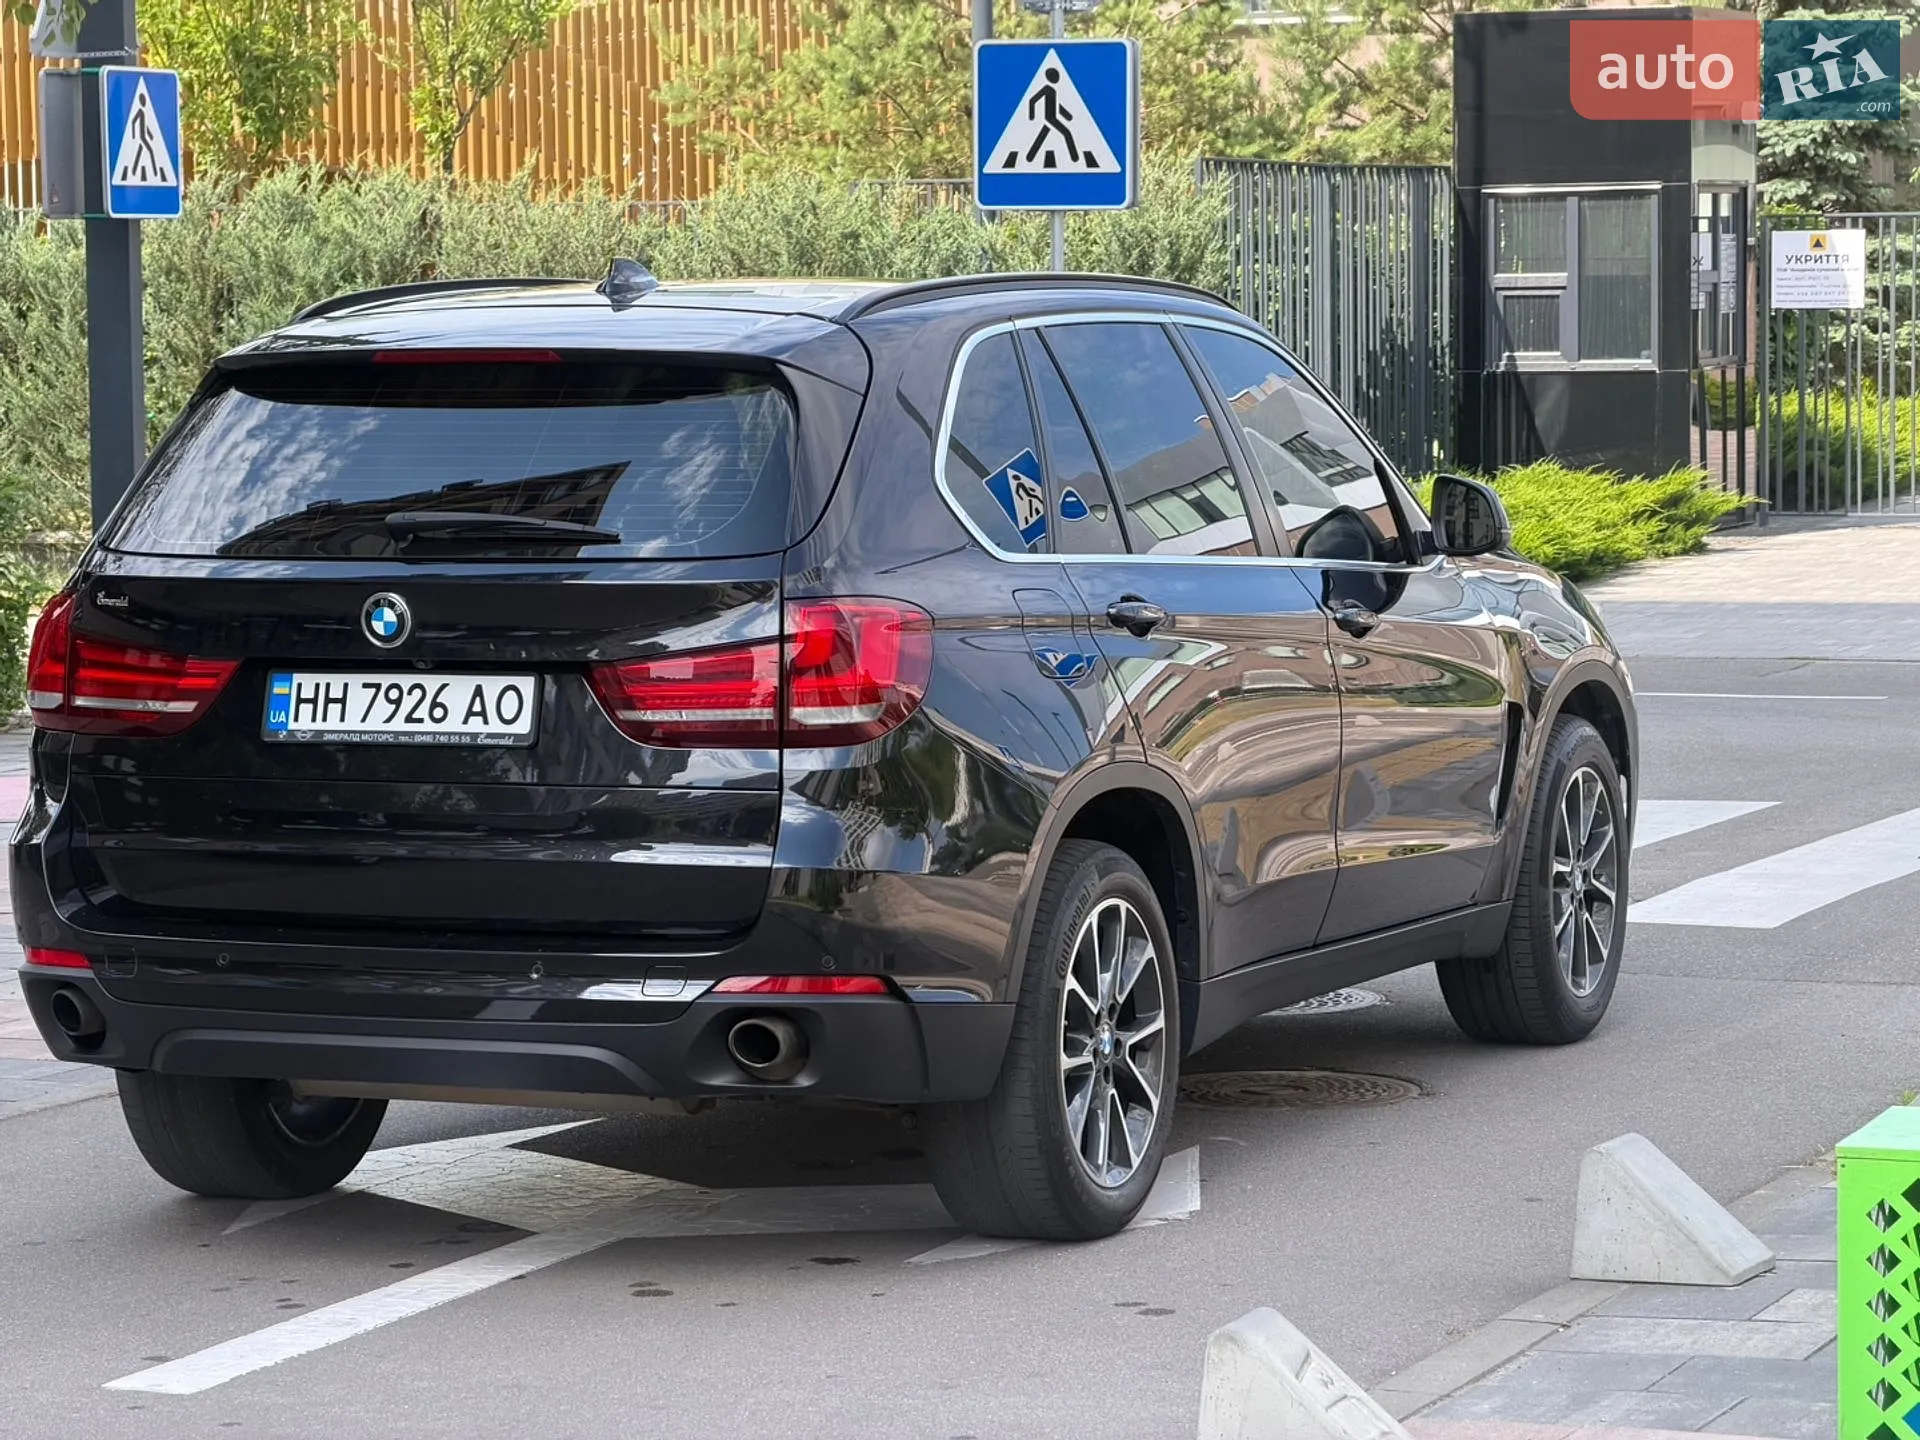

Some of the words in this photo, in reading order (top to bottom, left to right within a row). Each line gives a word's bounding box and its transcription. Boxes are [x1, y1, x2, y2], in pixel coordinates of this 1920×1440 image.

[1785, 254, 1850, 265] УКРИТТЯ
[293, 682, 349, 723] HH
[360, 682, 450, 724] 7926
[462, 684, 524, 726] AO
[270, 710, 287, 723] UA
[323, 733, 360, 742] ЭМЕРАЛД
[361, 733, 395, 742] МОТОРС
[434, 734, 449, 743] 740
[450, 735, 460, 743] 55
[461, 735, 471, 743] 55
[477, 733, 514, 745] Emerald
